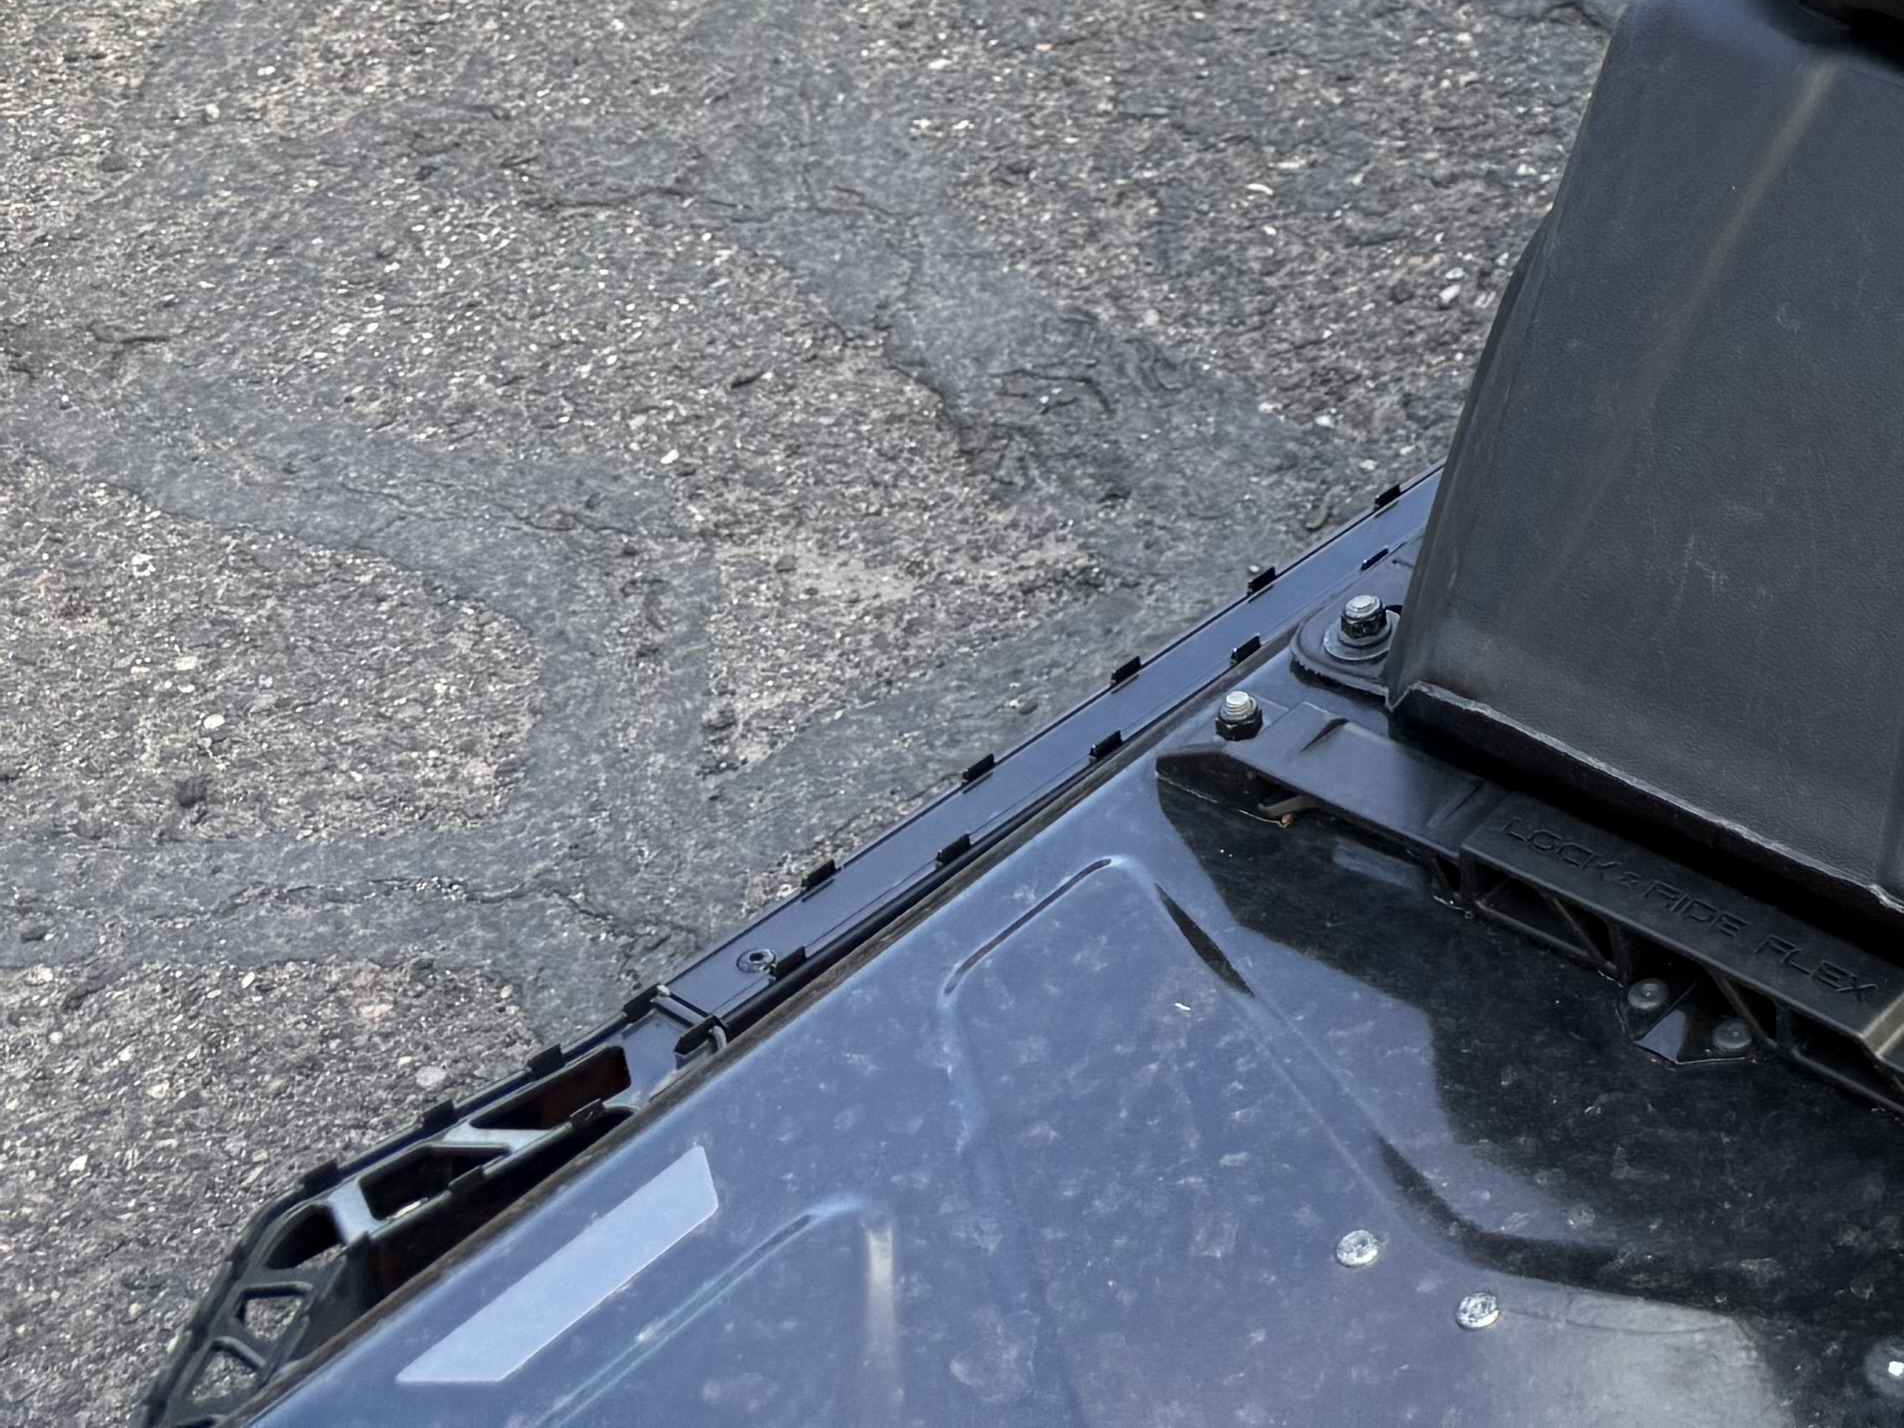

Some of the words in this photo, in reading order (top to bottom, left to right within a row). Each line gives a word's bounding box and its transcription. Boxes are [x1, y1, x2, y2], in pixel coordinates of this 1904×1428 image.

[1500, 816, 1622, 870] LOCK
[1640, 878, 1750, 938] RIDE
[1754, 934, 1878, 1003] FLEX
